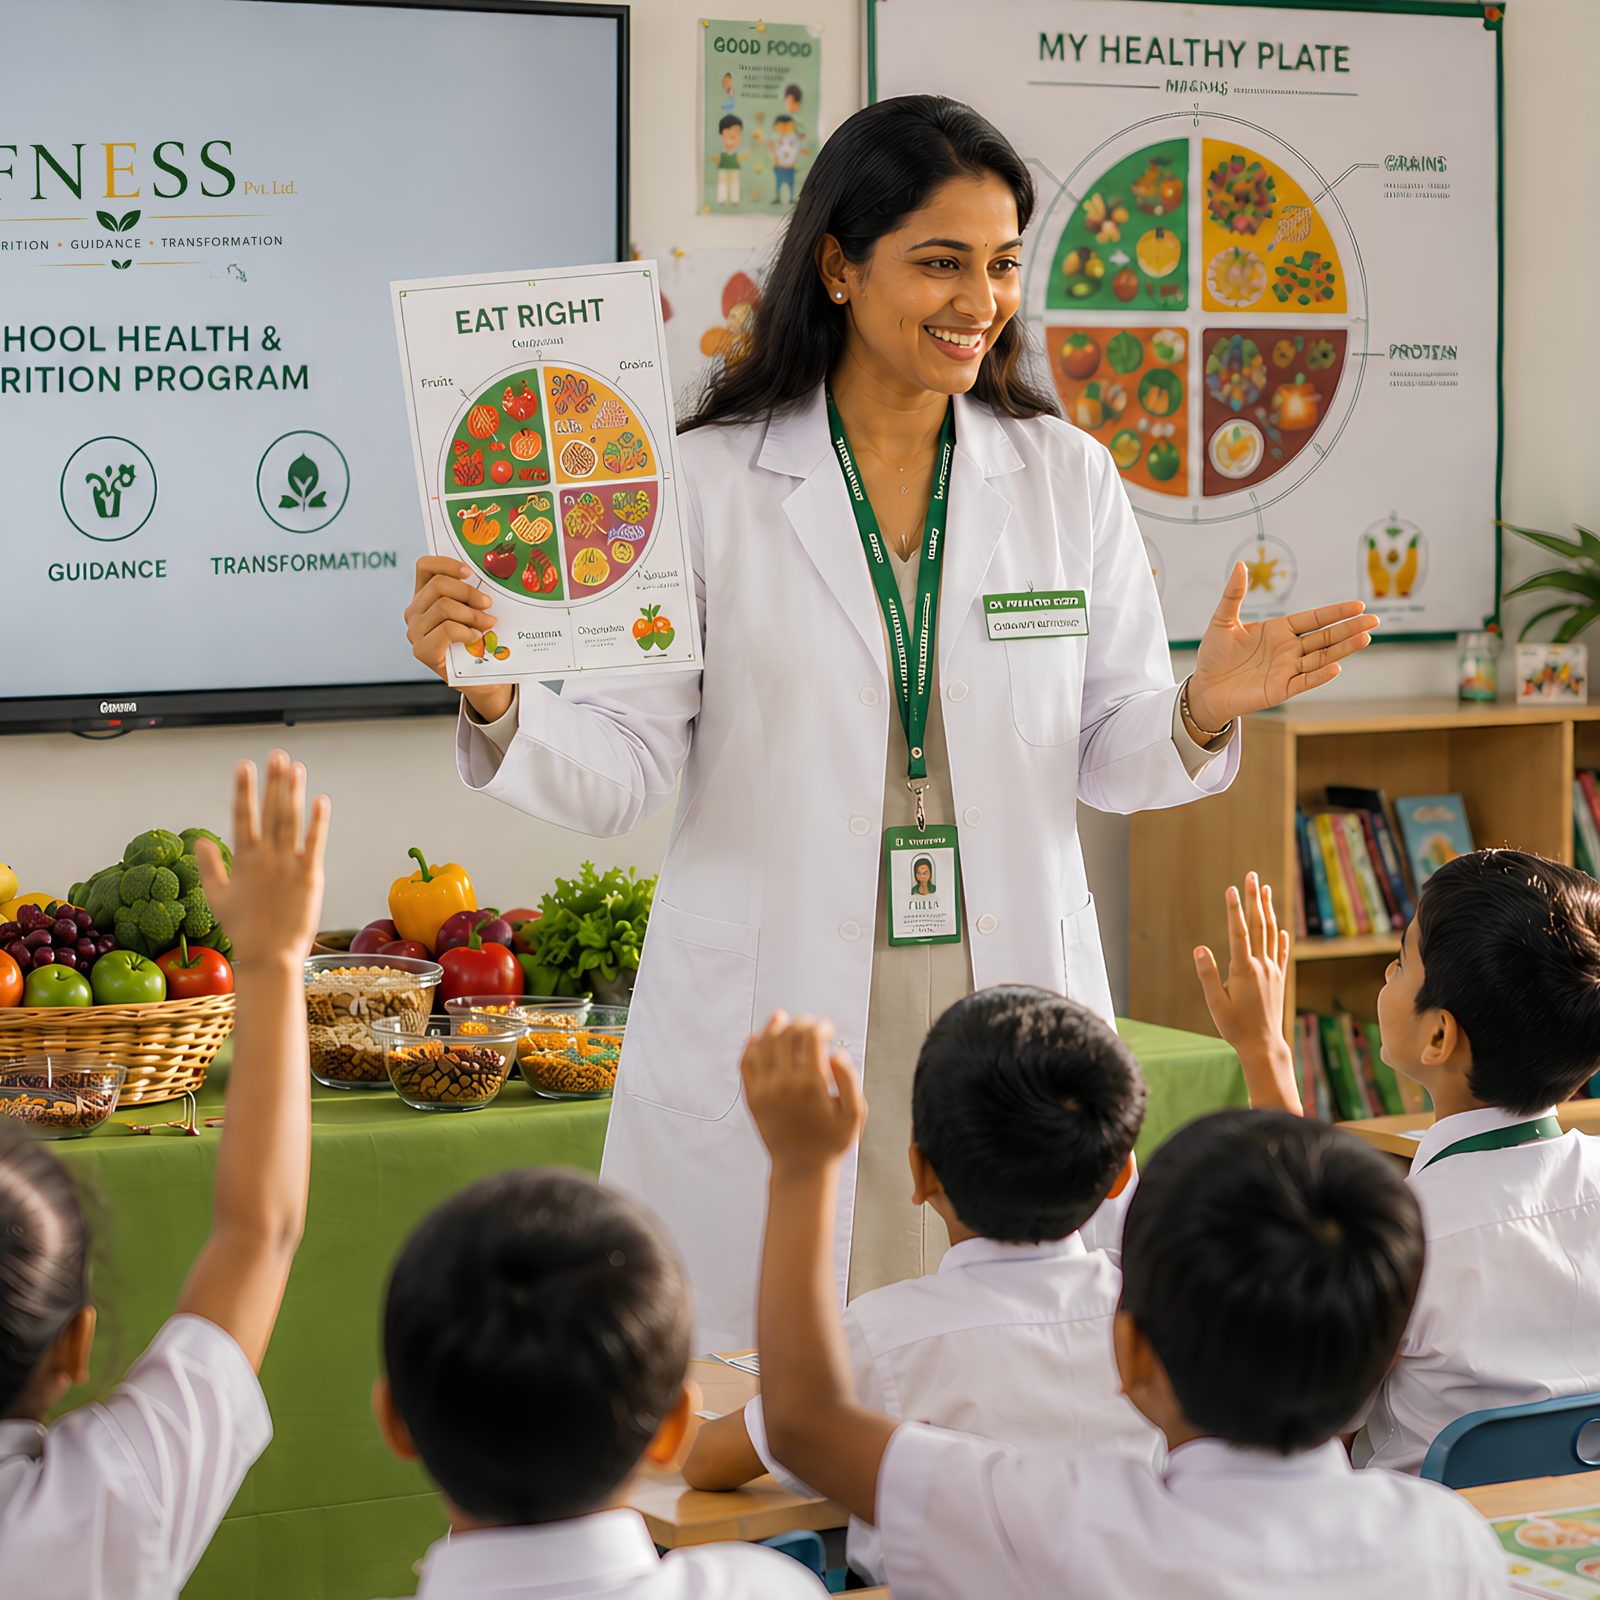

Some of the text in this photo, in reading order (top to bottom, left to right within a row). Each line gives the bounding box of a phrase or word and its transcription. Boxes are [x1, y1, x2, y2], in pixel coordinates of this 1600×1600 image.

[713, 36, 812, 58] GOOD FOOD
[1039, 32, 1351, 73] MY HEALTHY PLATE
[243, 181, 269, 195] Pvt.
[272, 180, 298, 195] Ltd.
[1, 235, 283, 251] RITION GUIDANCE TRANSFORMATION
[455, 297, 605, 335] EAT RIGHT
[4, 325, 282, 353] HOOL HEALTH &
[1, 364, 309, 394] RITION PROGRAM
[48, 551, 397, 582] GUIDANCE TRANSFORMATION
